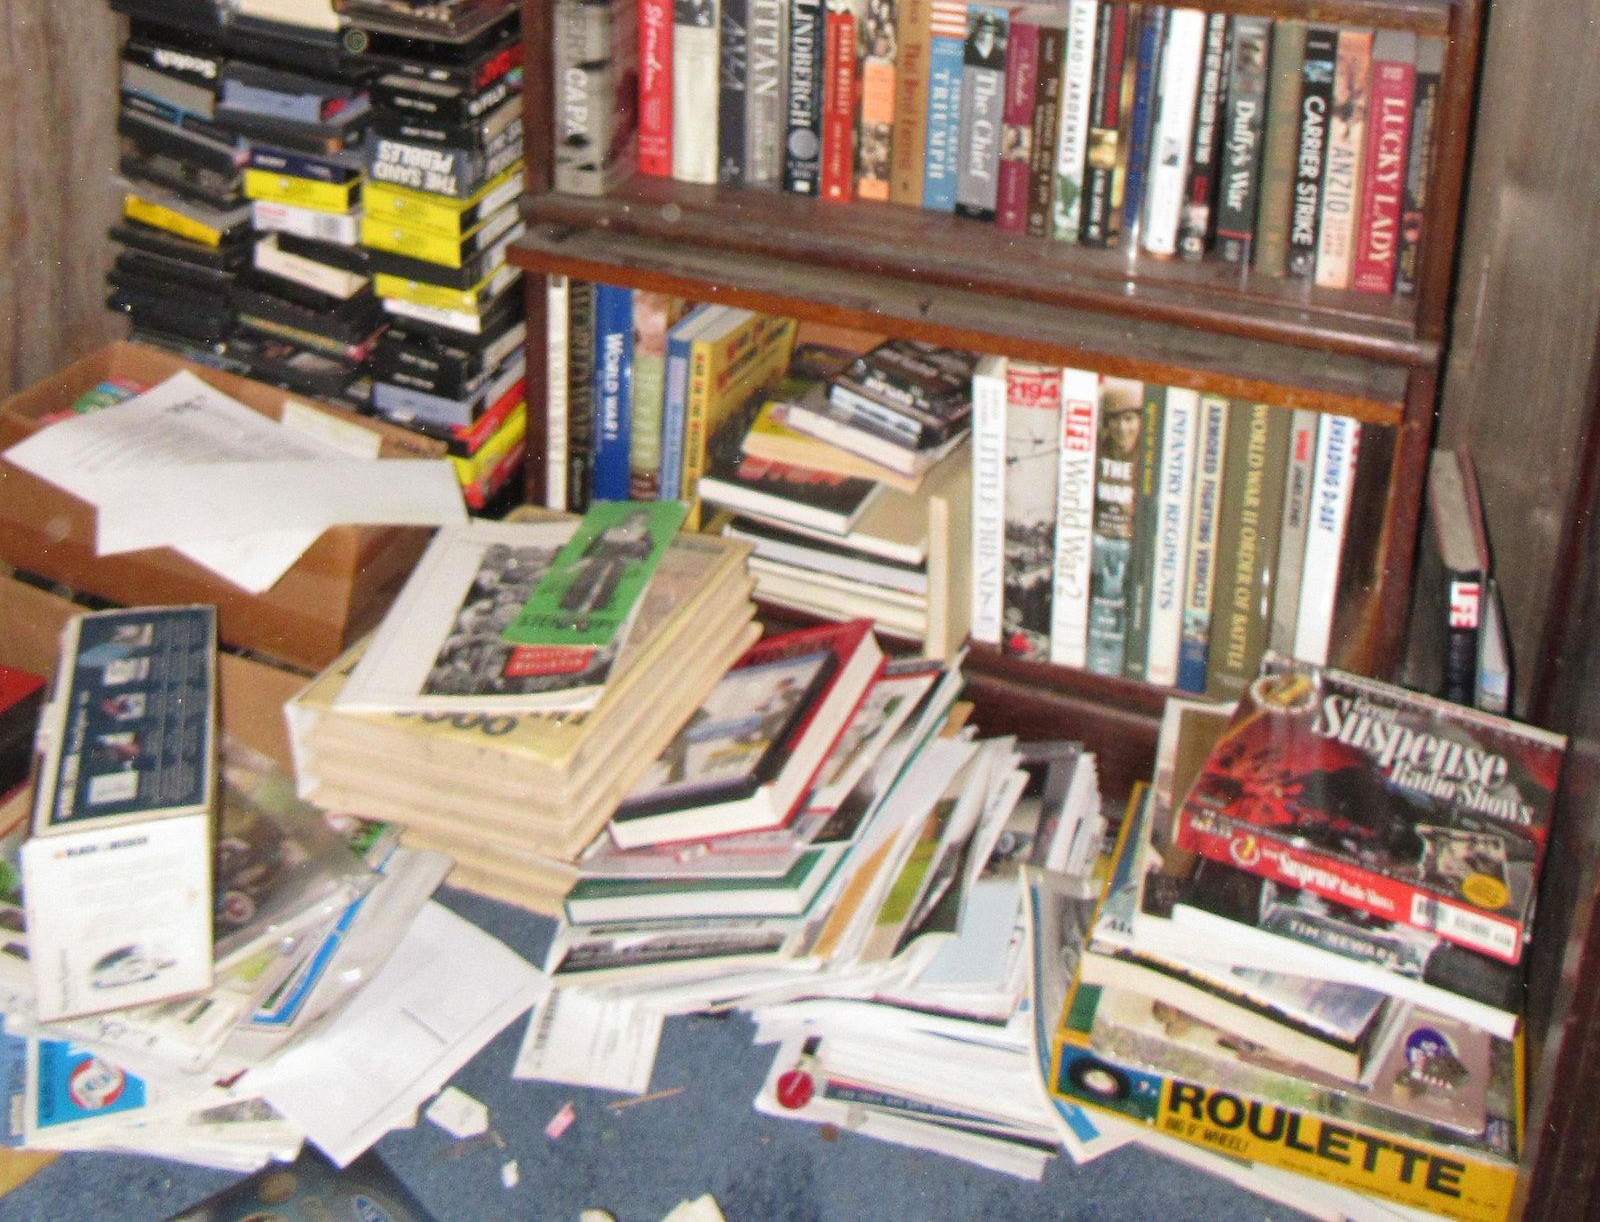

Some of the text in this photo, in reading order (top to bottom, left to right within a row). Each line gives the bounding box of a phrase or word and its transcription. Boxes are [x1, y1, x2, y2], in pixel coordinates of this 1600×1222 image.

[564, 67, 589, 134] CAPA
[1061, 6, 1089, 165] ALAMO ARDENNES
[377, 138, 455, 173] PEBBLES
[927, 68, 950, 181] TRIUMPH
[969, 70, 998, 180] The Chief
[1226, 99, 1256, 212] Duffy's War
[372, 160, 458, 195] THE SAND
[1291, 95, 1326, 246] CARRIER STRIKE
[1325, 144, 1355, 214] ANZIO
[1368, 96, 1407, 264] LUCKY LADY
[604, 332, 625, 394] WORLD
[1006, 379, 1059, 403] 2194
[603, 395, 620, 432] WAR
[1066, 399, 1093, 452] LIFE
[1247, 402, 1270, 467] WORLD
[979, 432, 1000, 507] LITTLE
[1099, 458, 1133, 480] THE
[1244, 467, 1266, 509] WAR
[1057, 456, 1091, 600] World War 2
[1158, 406, 1187, 610] INFANTRY REGIMENTS
[1191, 404, 1221, 609] ARMORED FIGHTING VEHICLES
[1234, 525, 1257, 579] ORDER
[1232, 580, 1252, 610] OF
[1227, 610, 1250, 669] BATTLE
[1311, 693, 1509, 788] Suspense
[1389, 757, 1536, 827] Radio Shows
[1277, 850, 1341, 893] Suspense
[1288, 919, 1321, 940] TIM
[1166, 1079, 1468, 1201] ROULETTE
